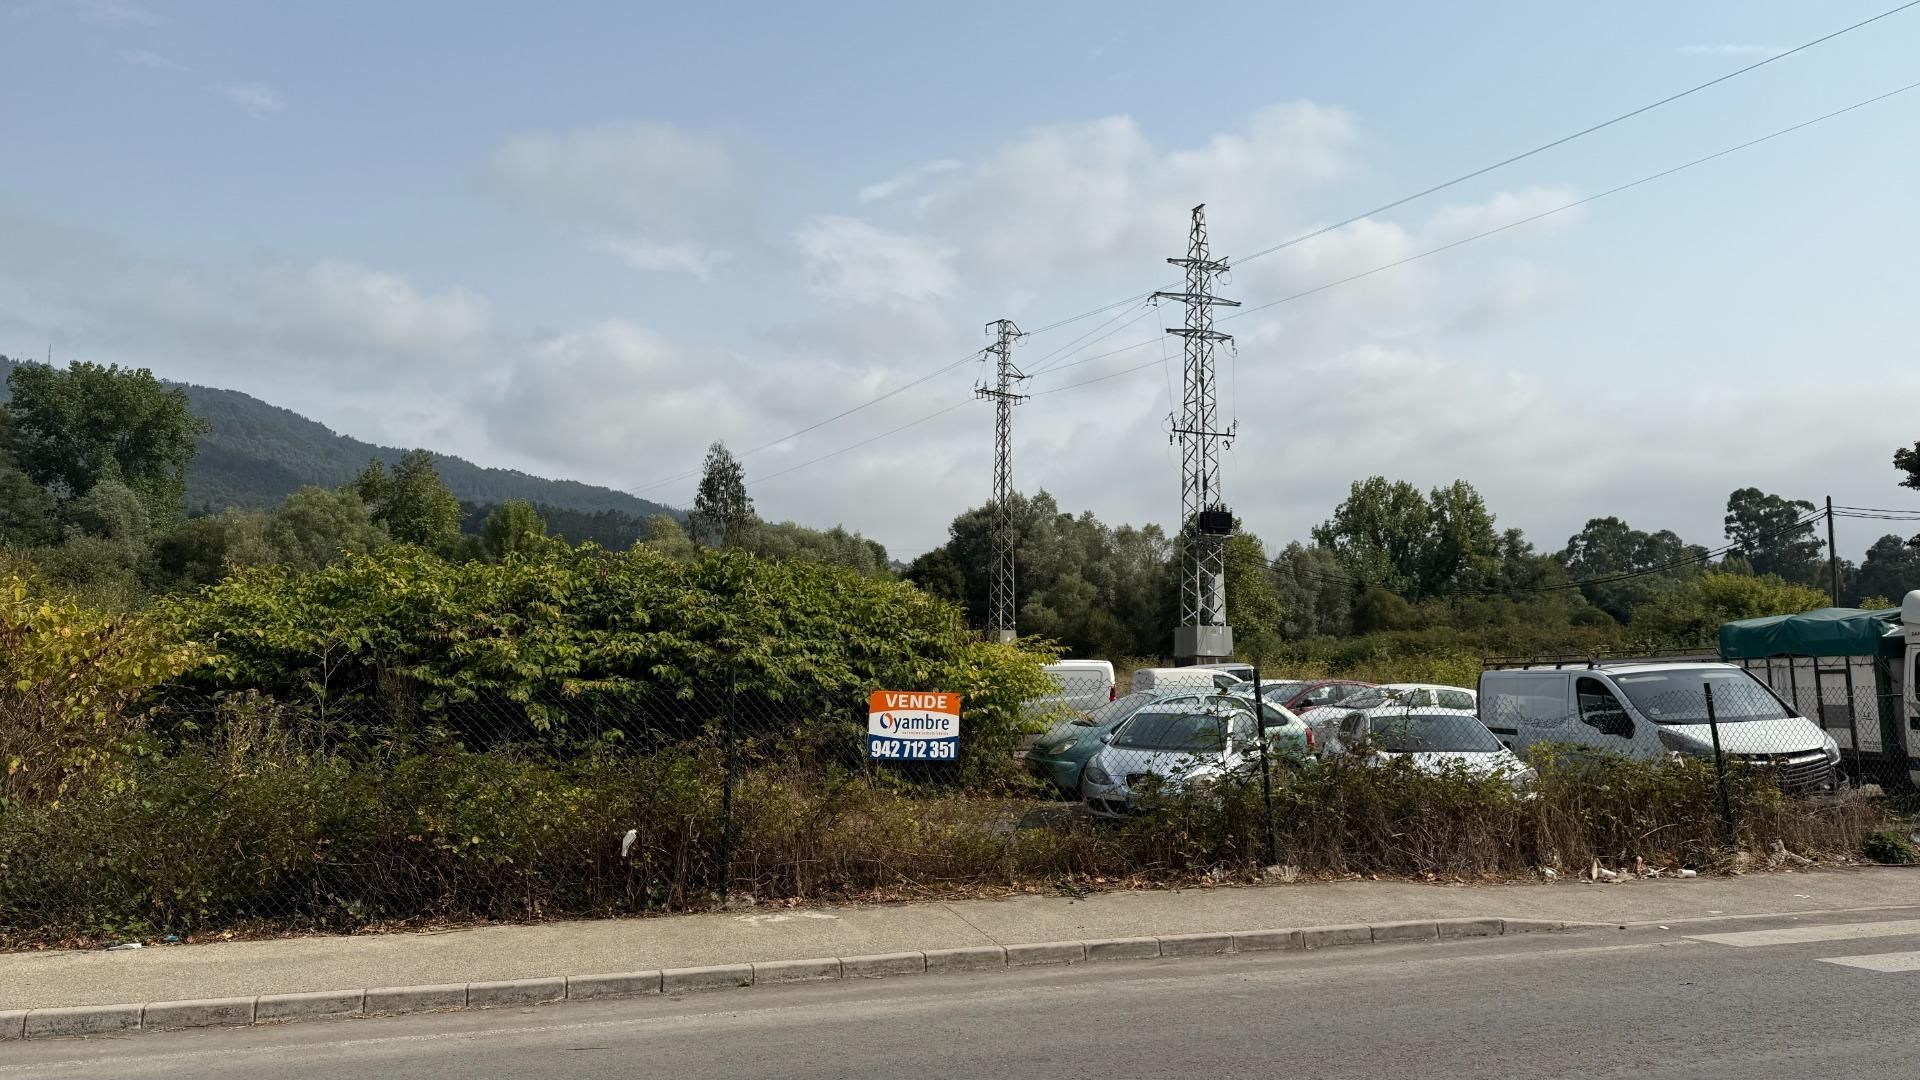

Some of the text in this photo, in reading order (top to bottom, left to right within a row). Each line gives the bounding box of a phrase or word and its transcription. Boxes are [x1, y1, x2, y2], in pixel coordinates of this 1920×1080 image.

[885, 693, 947, 709] VENDE
[880, 712, 949, 734] Oyambre
[871, 740, 955, 758] 942 712 351
